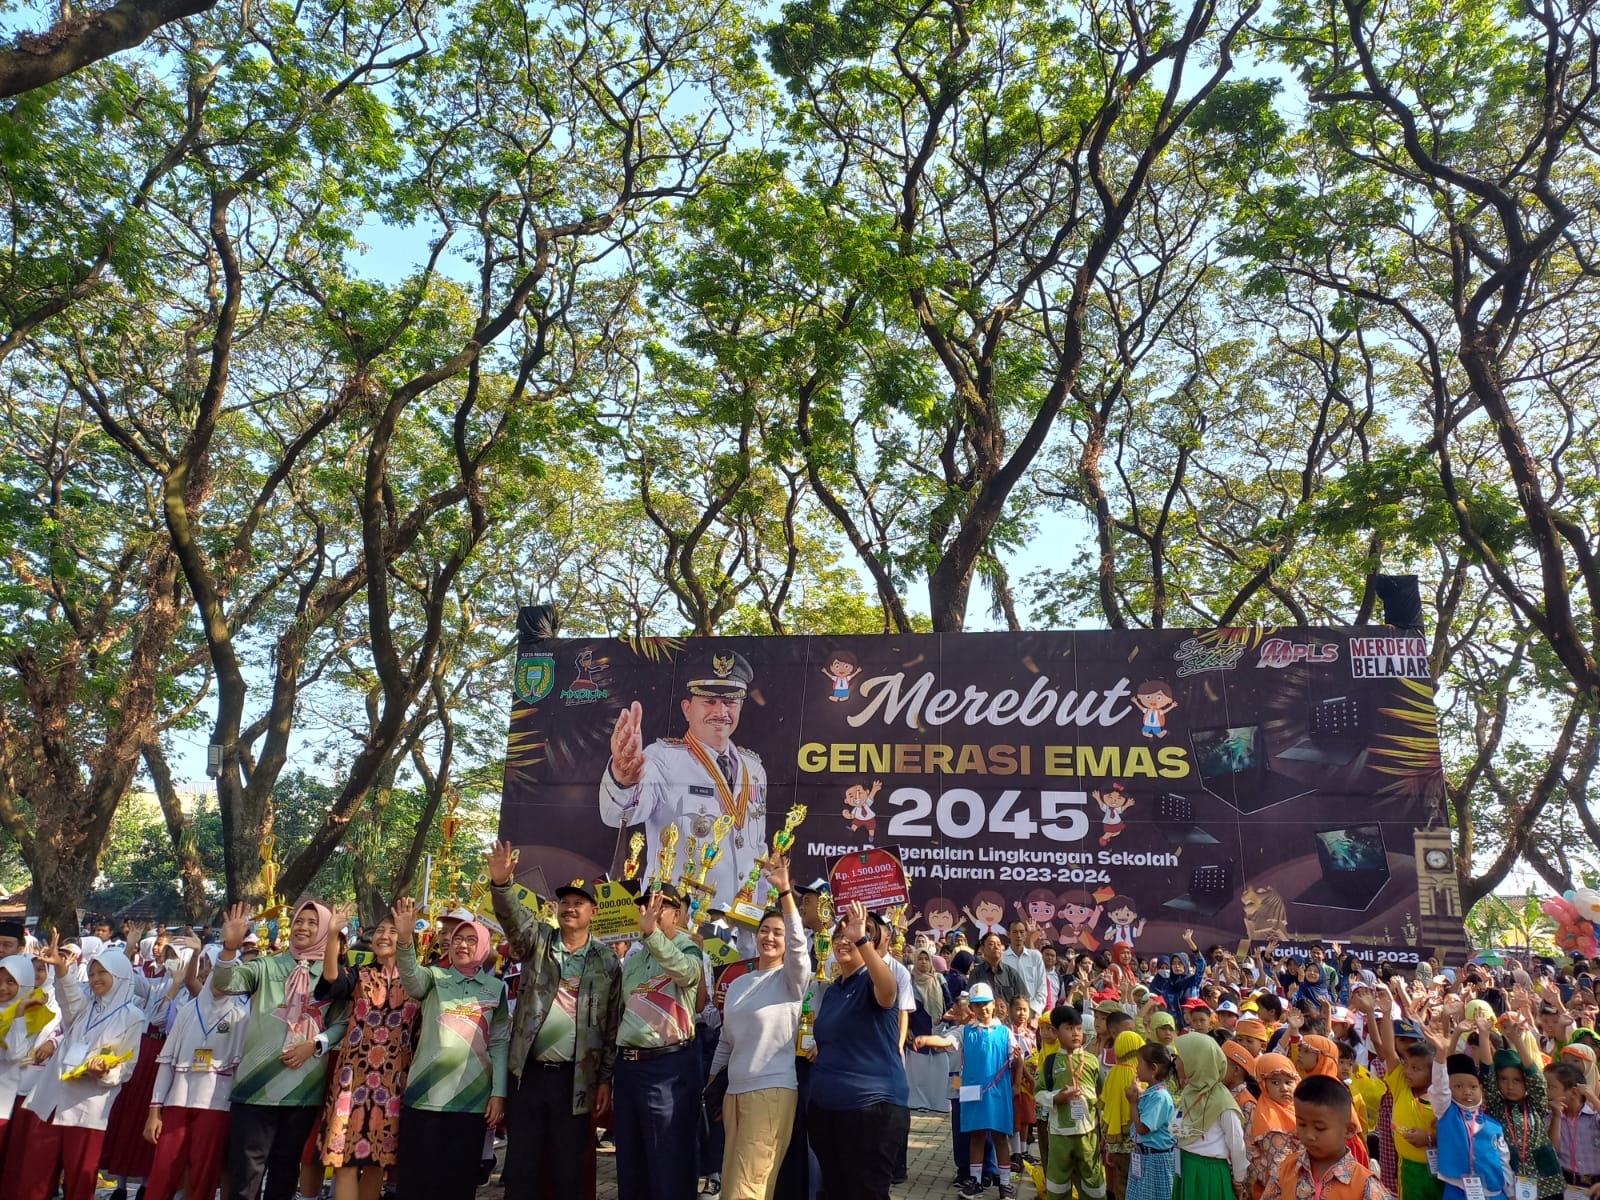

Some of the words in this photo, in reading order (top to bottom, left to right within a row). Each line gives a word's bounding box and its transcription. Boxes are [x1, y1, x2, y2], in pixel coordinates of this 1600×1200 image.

[1257, 639, 1339, 668] MPLS
[1350, 638, 1427, 656] MERDEKA
[1177, 651, 1242, 677] School
[1354, 657, 1429, 677] BELAJAR
[847, 671, 1132, 729] Merebut
[798, 742, 1031, 775] GENERASI
[1045, 745, 1190, 778] EMAS
[887, 787, 1089, 841] 2045
[807, 843, 854, 857] Masa
[863, 844, 974, 862] Pgenalan
[978, 847, 1093, 865] Lingkungan
[1098, 851, 1179, 867] Sekolah
[834, 872, 850, 880] Rp.
[930, 864, 995, 880] Ajaran
[999, 867, 1111, 884] 2023-2024
[1377, 951, 1420, 963] 2023
